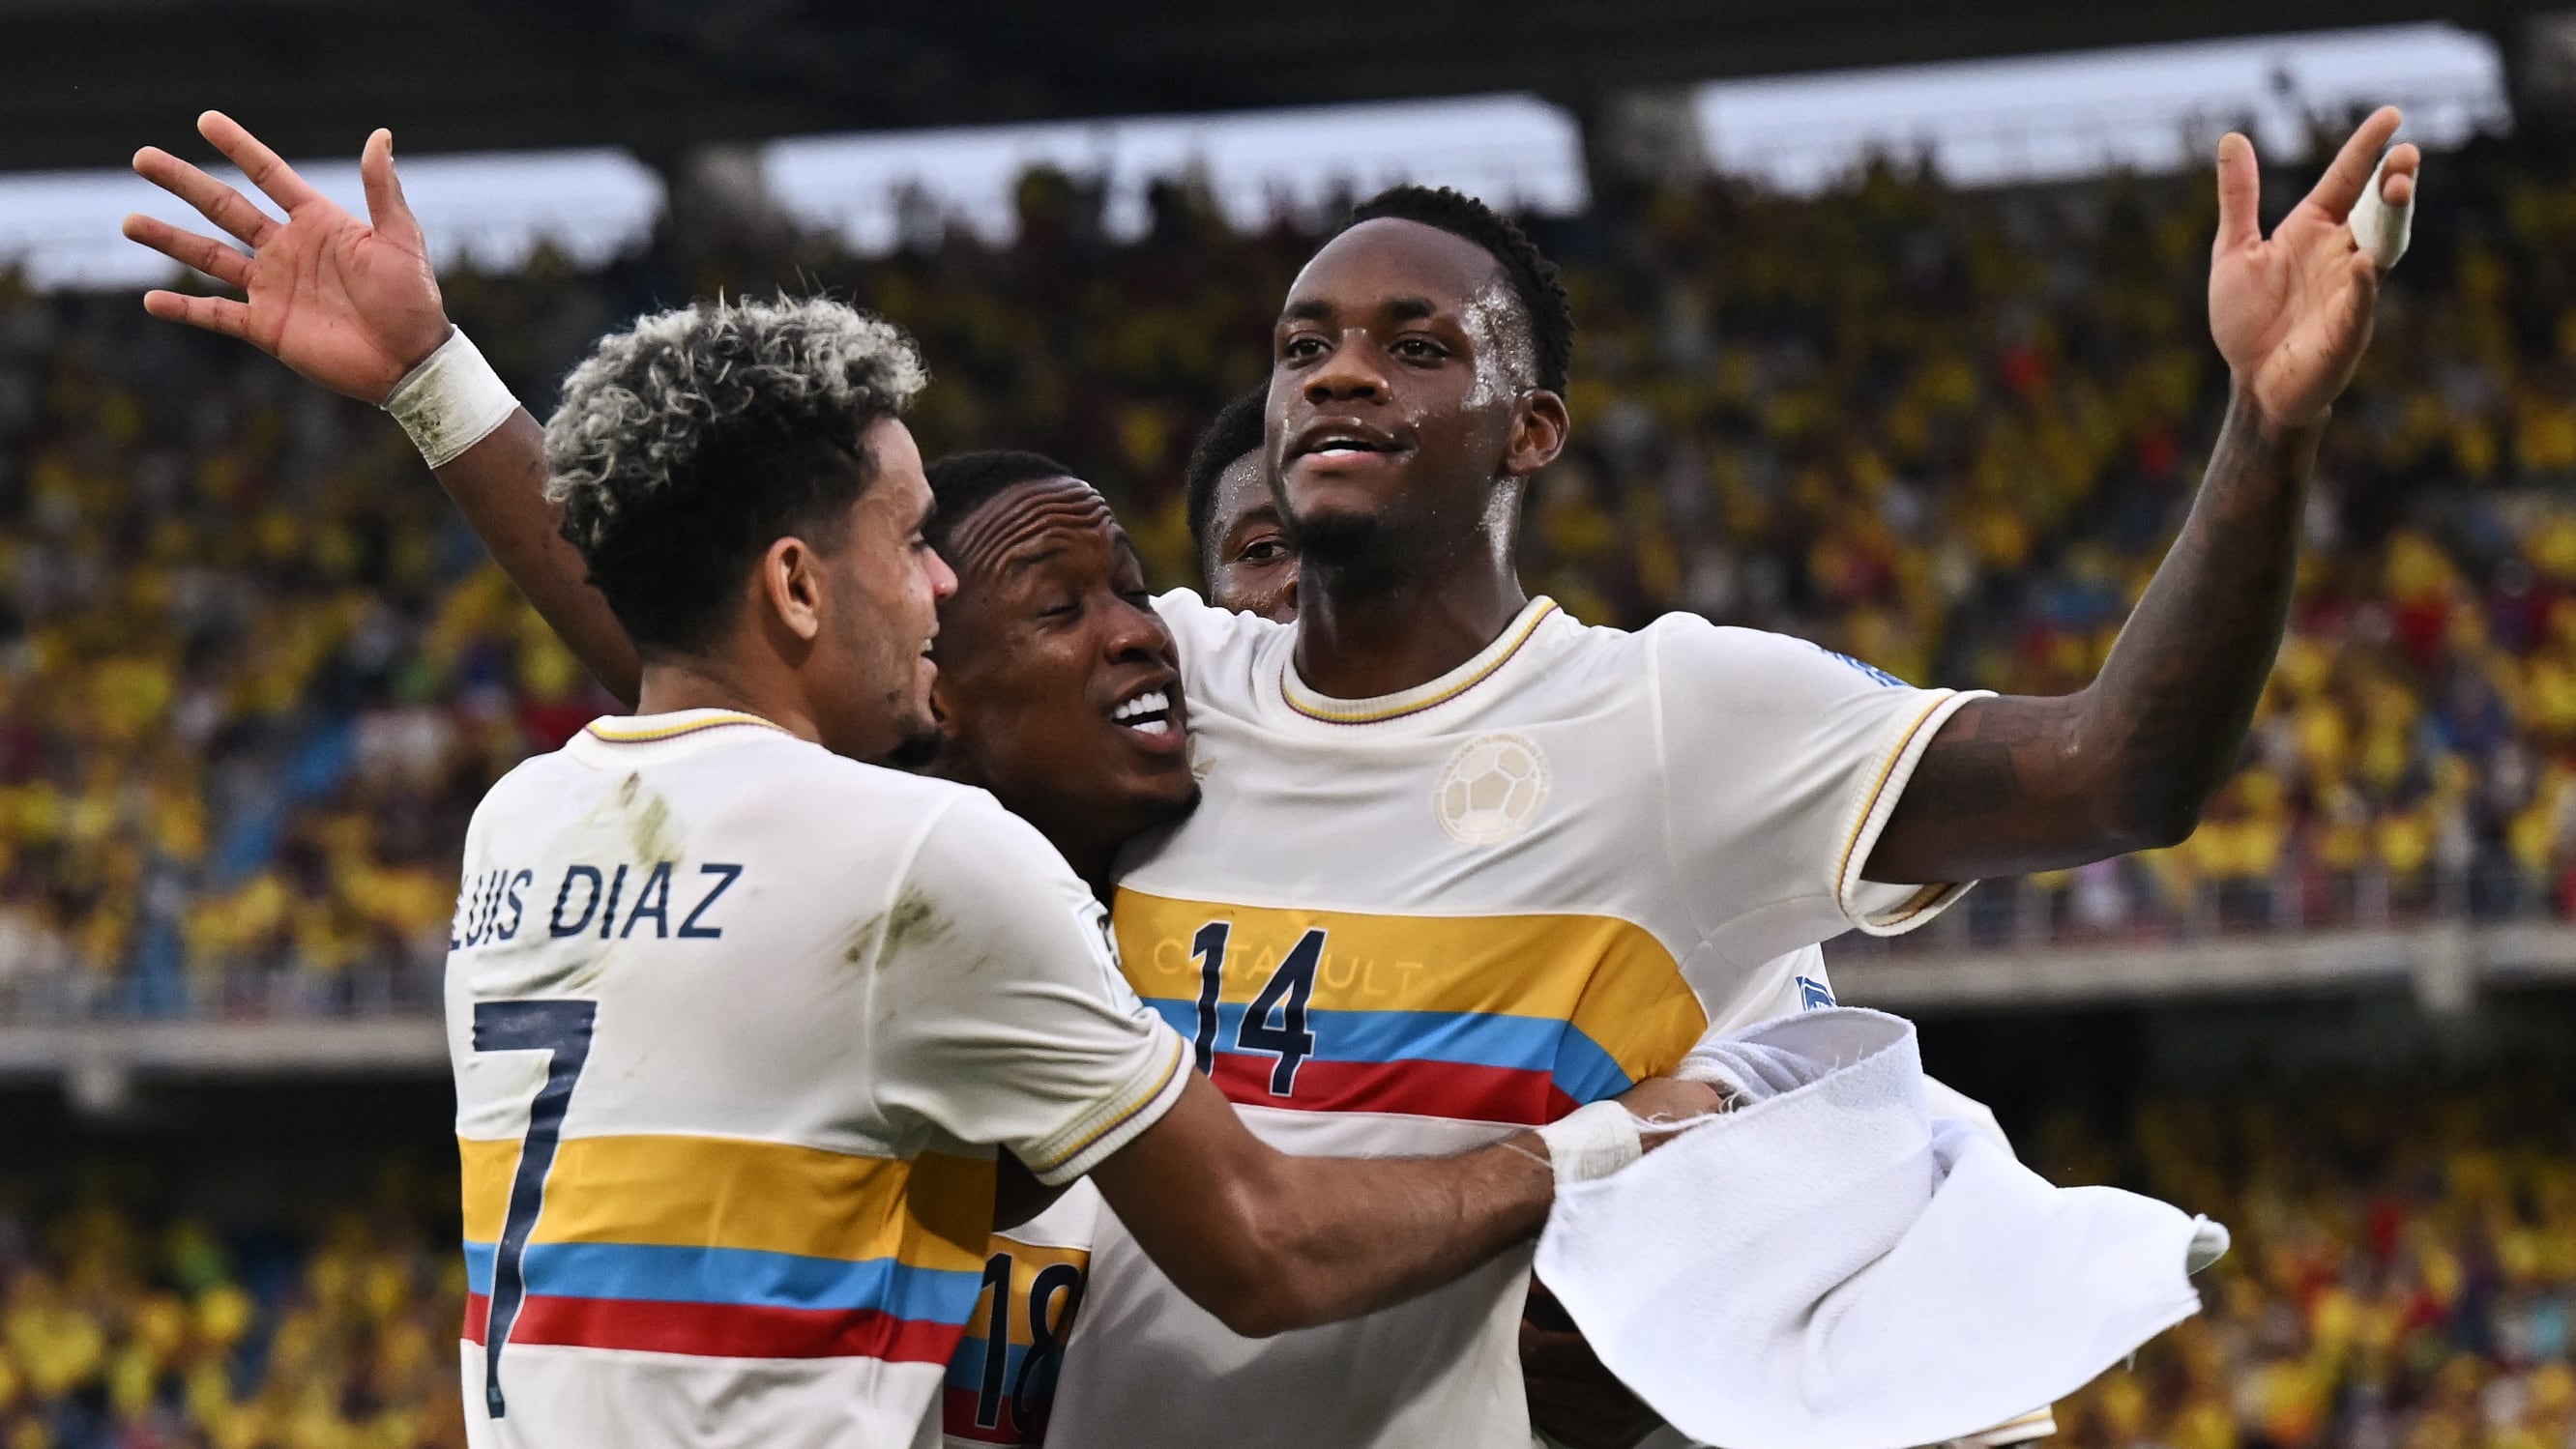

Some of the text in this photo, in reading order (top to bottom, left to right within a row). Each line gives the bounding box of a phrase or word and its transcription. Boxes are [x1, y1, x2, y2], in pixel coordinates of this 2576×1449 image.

[549, 860, 745, 940] DIAZ
[1153, 939, 1424, 1000] CTAULT
[1188, 919, 1329, 1097] 14
[472, 999, 599, 1419] 7
[975, 1251, 1083, 1436] 18
